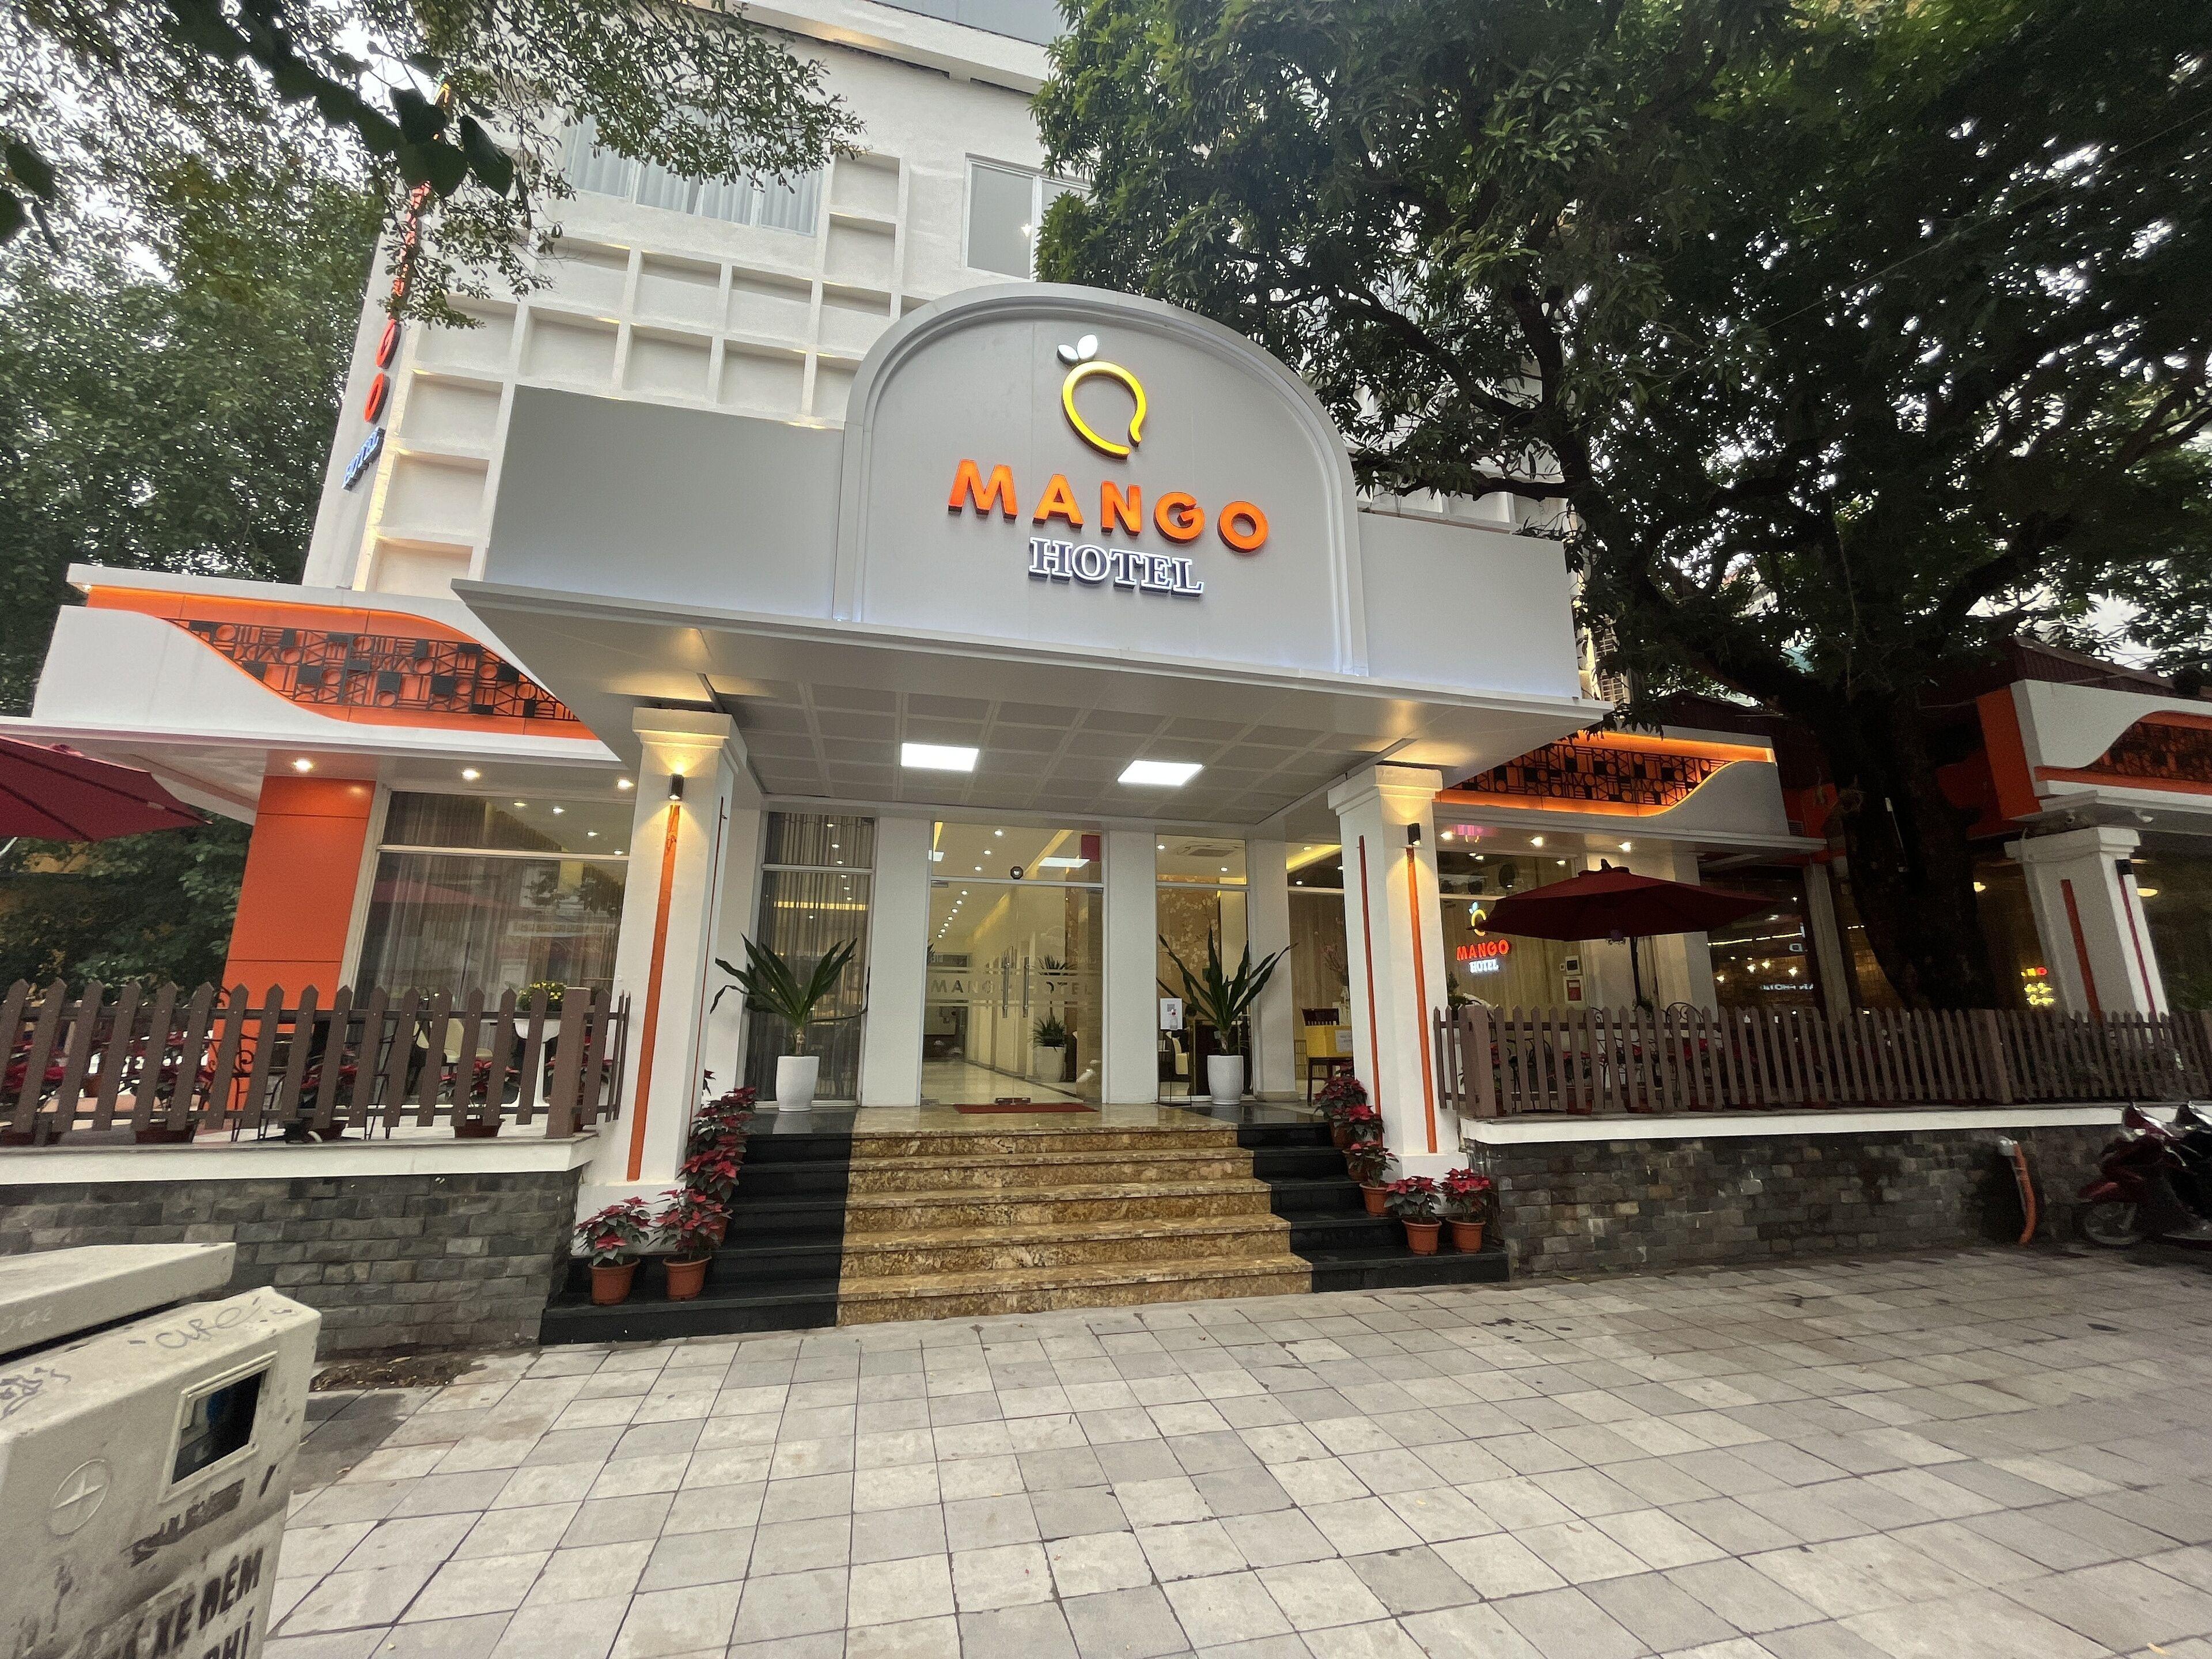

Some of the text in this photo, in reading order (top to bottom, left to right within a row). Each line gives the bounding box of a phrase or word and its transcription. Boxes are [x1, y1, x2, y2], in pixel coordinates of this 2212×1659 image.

[948, 459, 1268, 552] MANGO
[1028, 537, 1204, 596] HOTEL
[1456, 939, 1509, 961] MANGO
[1469, 959, 1499, 974] HOTEL
